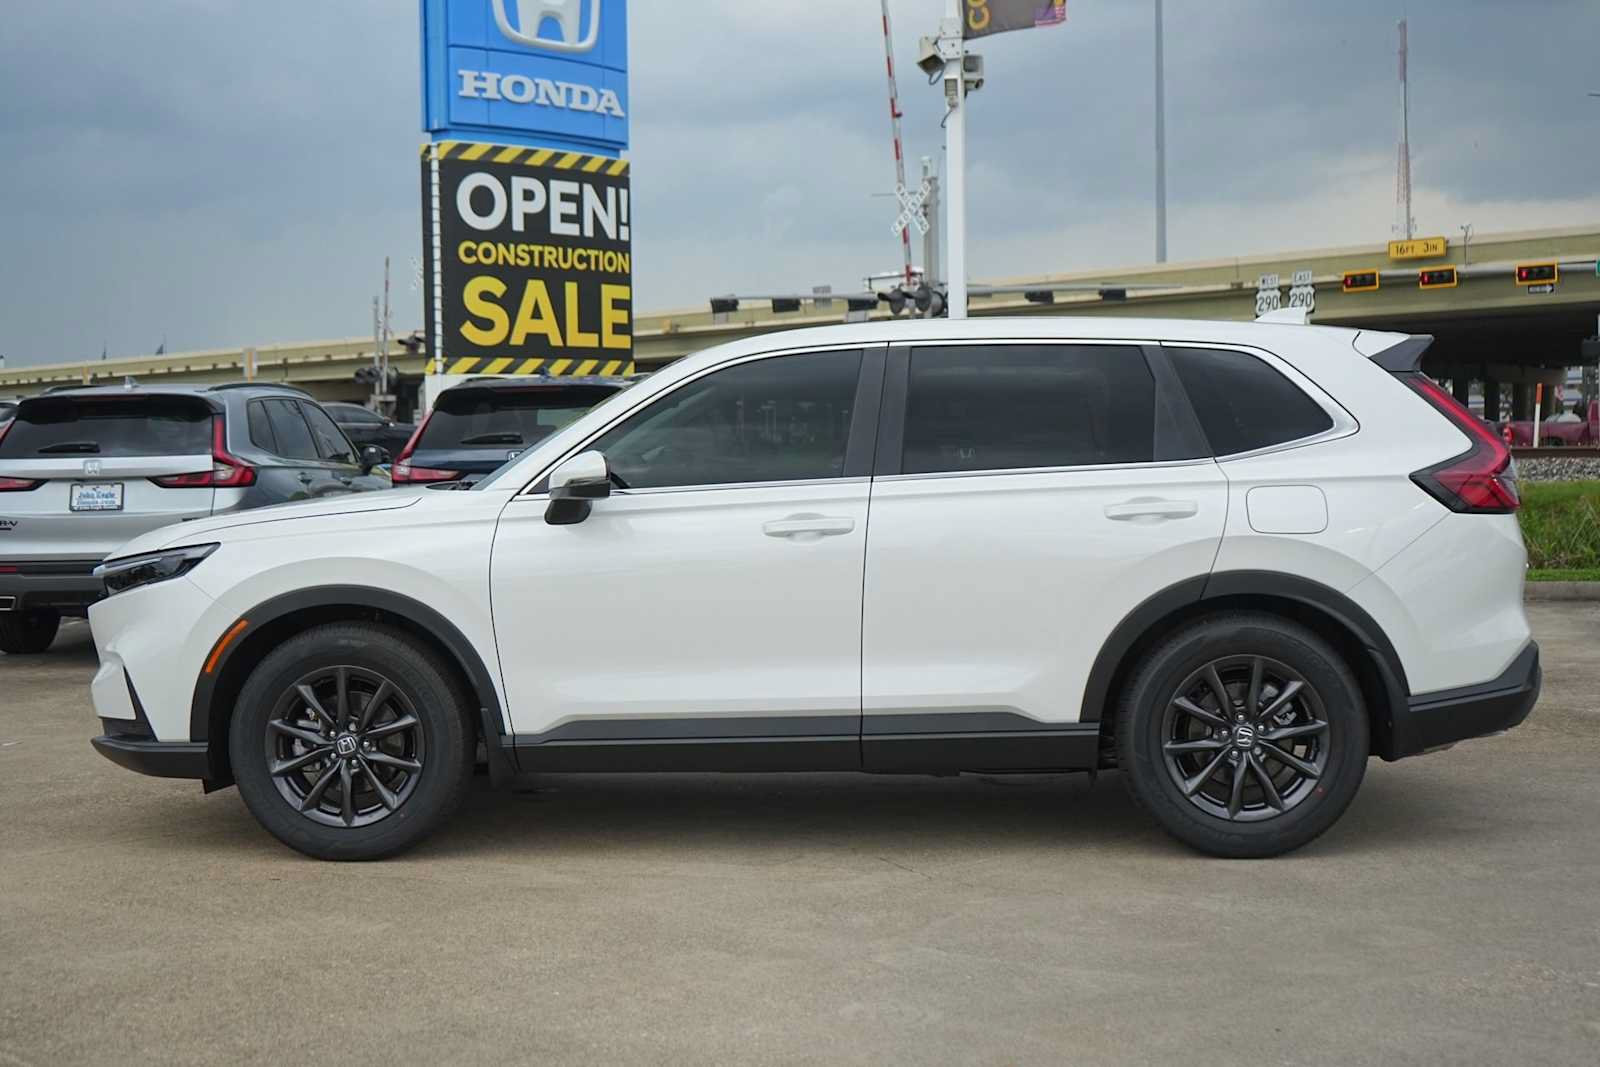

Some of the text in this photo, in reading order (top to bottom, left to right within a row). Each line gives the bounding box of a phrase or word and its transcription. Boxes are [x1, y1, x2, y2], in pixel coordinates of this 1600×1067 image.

[458, 69, 625, 118] HONDA
[456, 171, 629, 241] OPEN!
[458, 240, 630, 273] CONSTRUCTION
[459, 275, 631, 349] SALE
[1258, 294, 1279, 312] 290
[1291, 291, 1312, 307] 290
